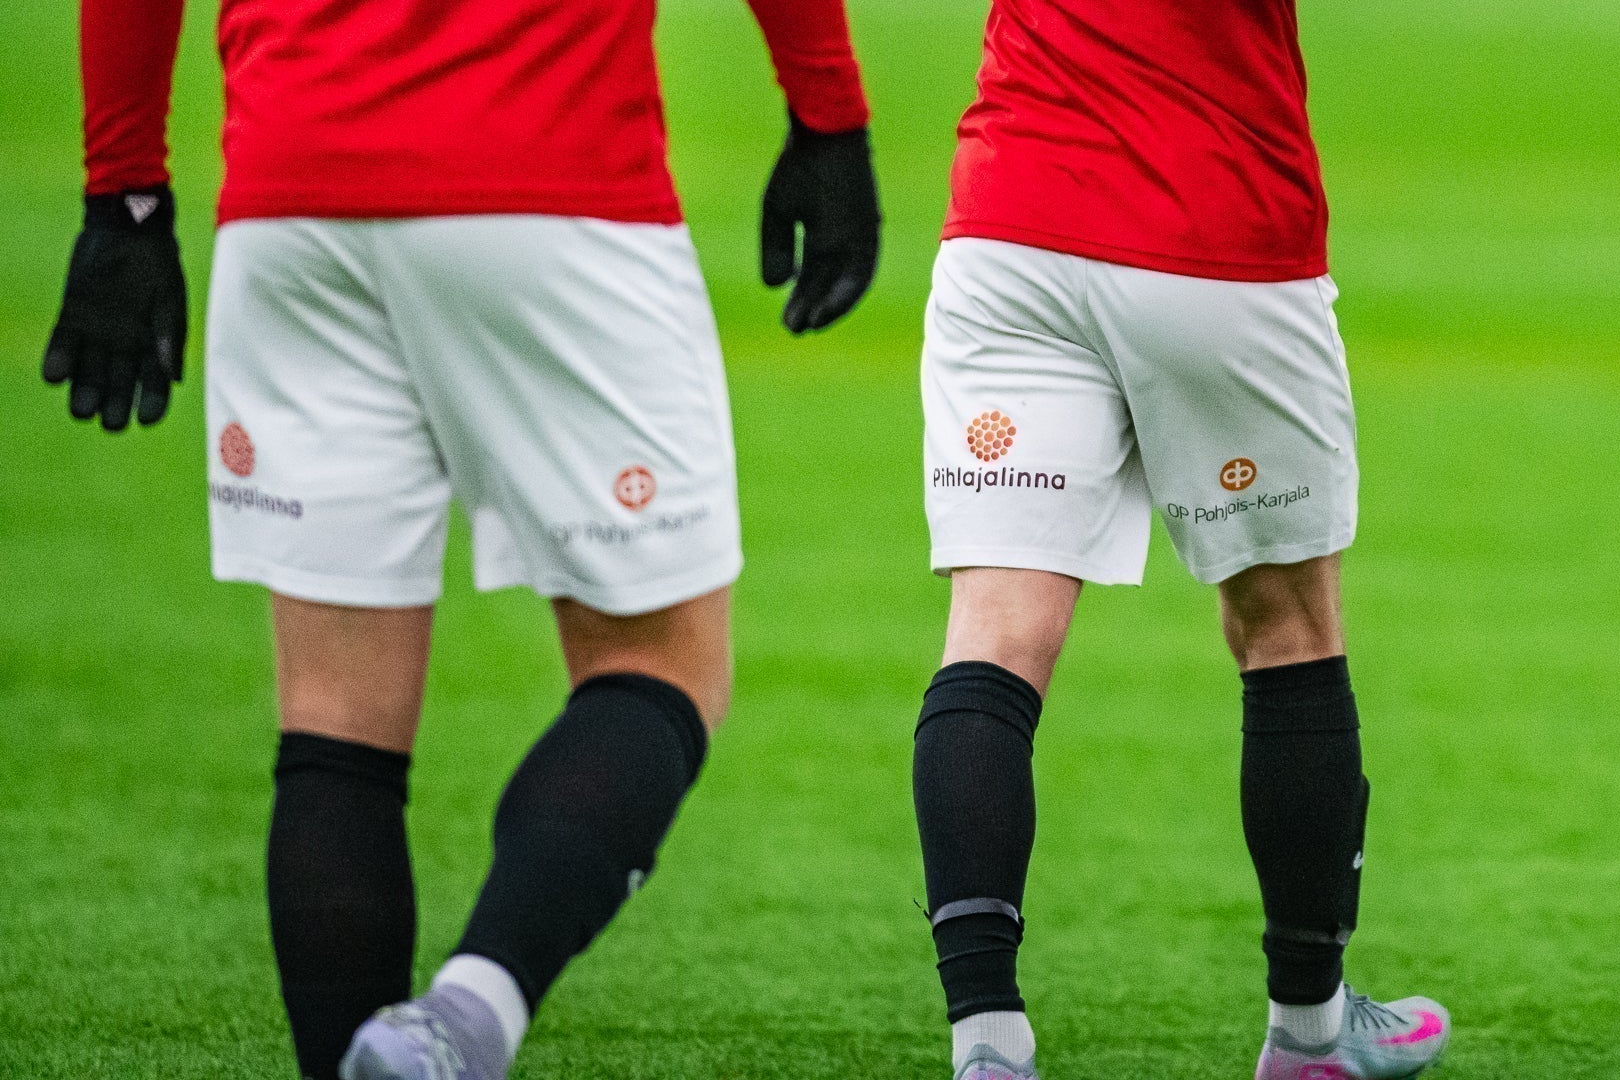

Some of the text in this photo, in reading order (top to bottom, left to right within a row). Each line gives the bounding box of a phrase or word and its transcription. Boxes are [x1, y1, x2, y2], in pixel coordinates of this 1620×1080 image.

[933, 467, 1066, 493] Pihlajalinna
[1167, 484, 1310, 525] OP Pohjois-Karjala
